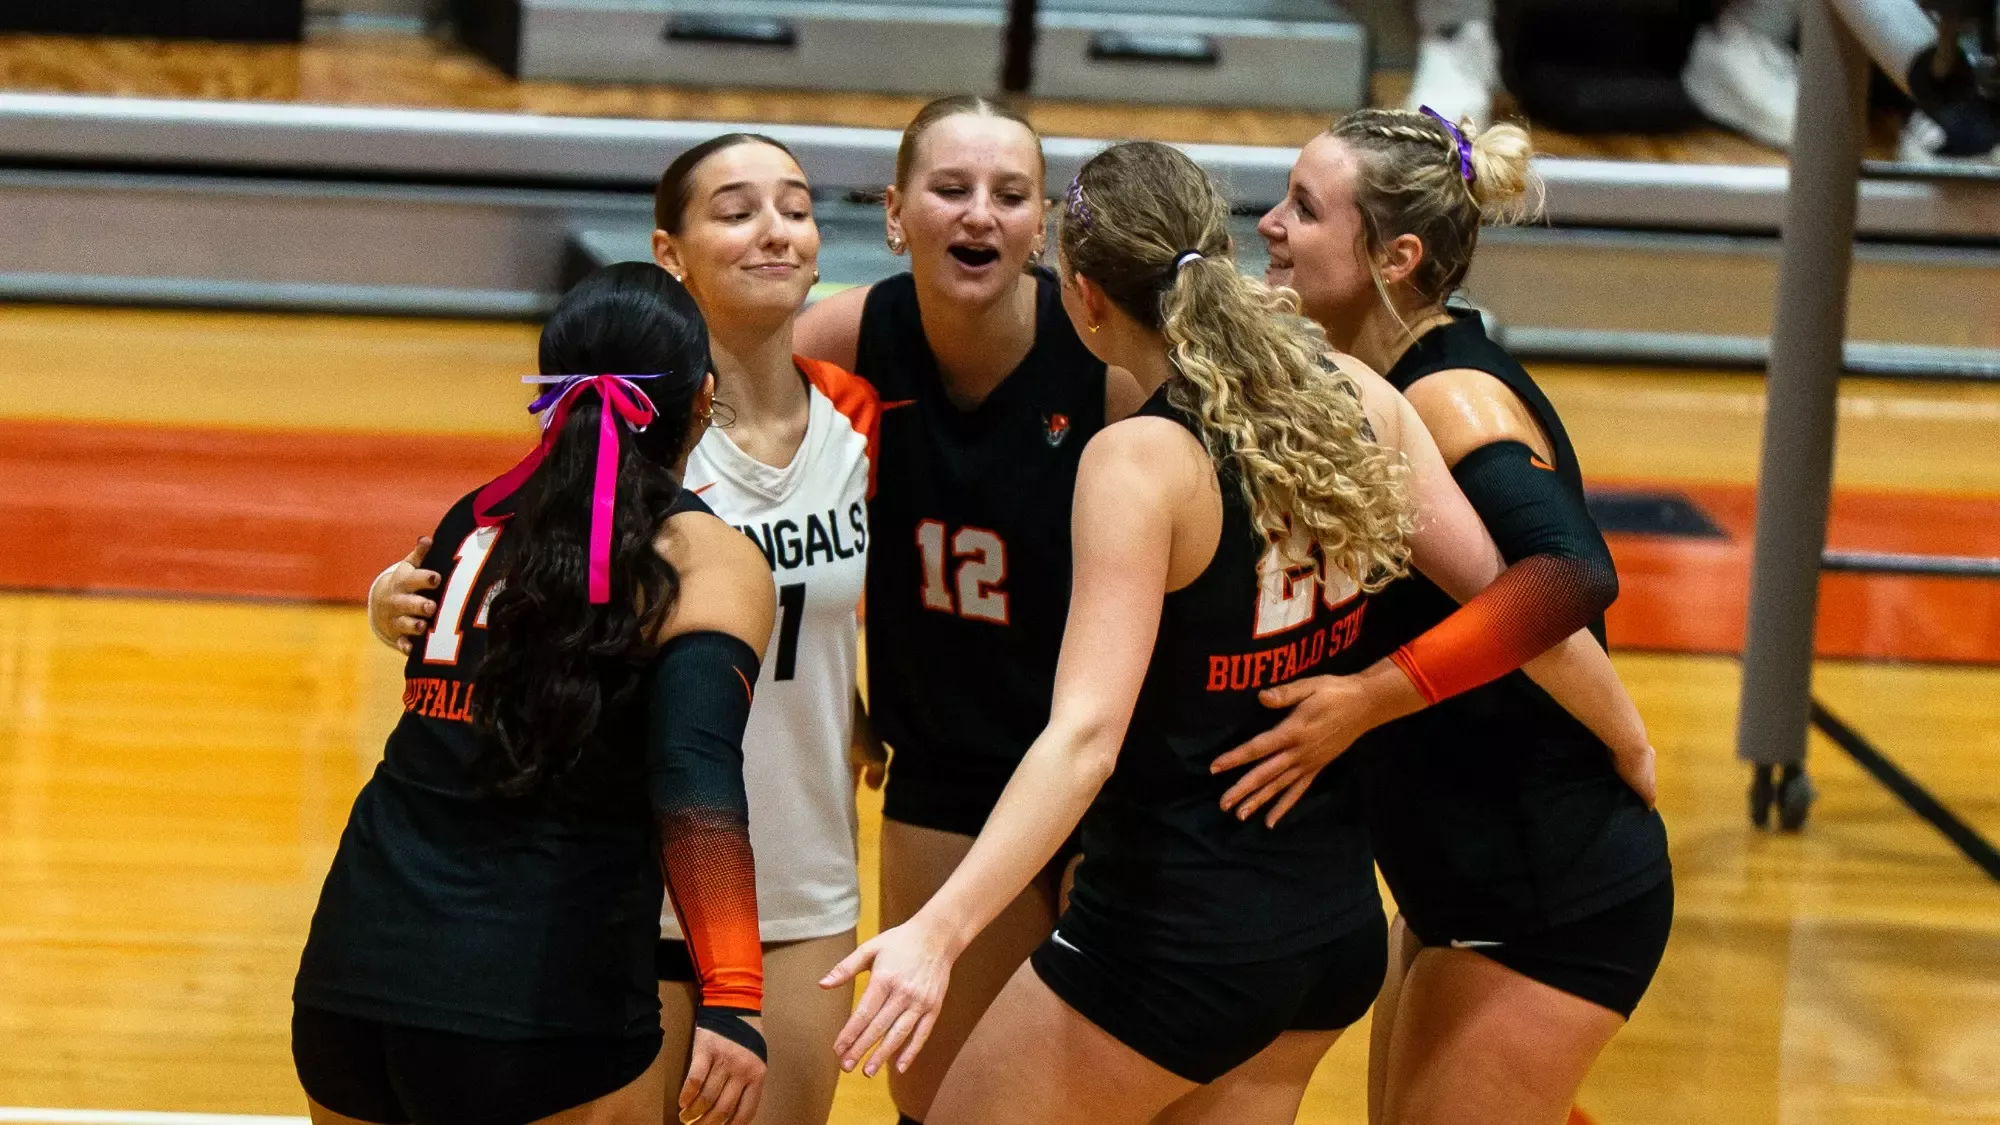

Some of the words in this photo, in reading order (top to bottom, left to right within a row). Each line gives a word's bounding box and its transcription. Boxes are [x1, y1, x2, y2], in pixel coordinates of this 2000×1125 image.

[733, 502, 866, 572] NGALS
[915, 518, 1009, 625] 12
[423, 525, 507, 666] 1
[774, 582, 806, 682] 1
[1207, 628, 1326, 692] BUFFALO
